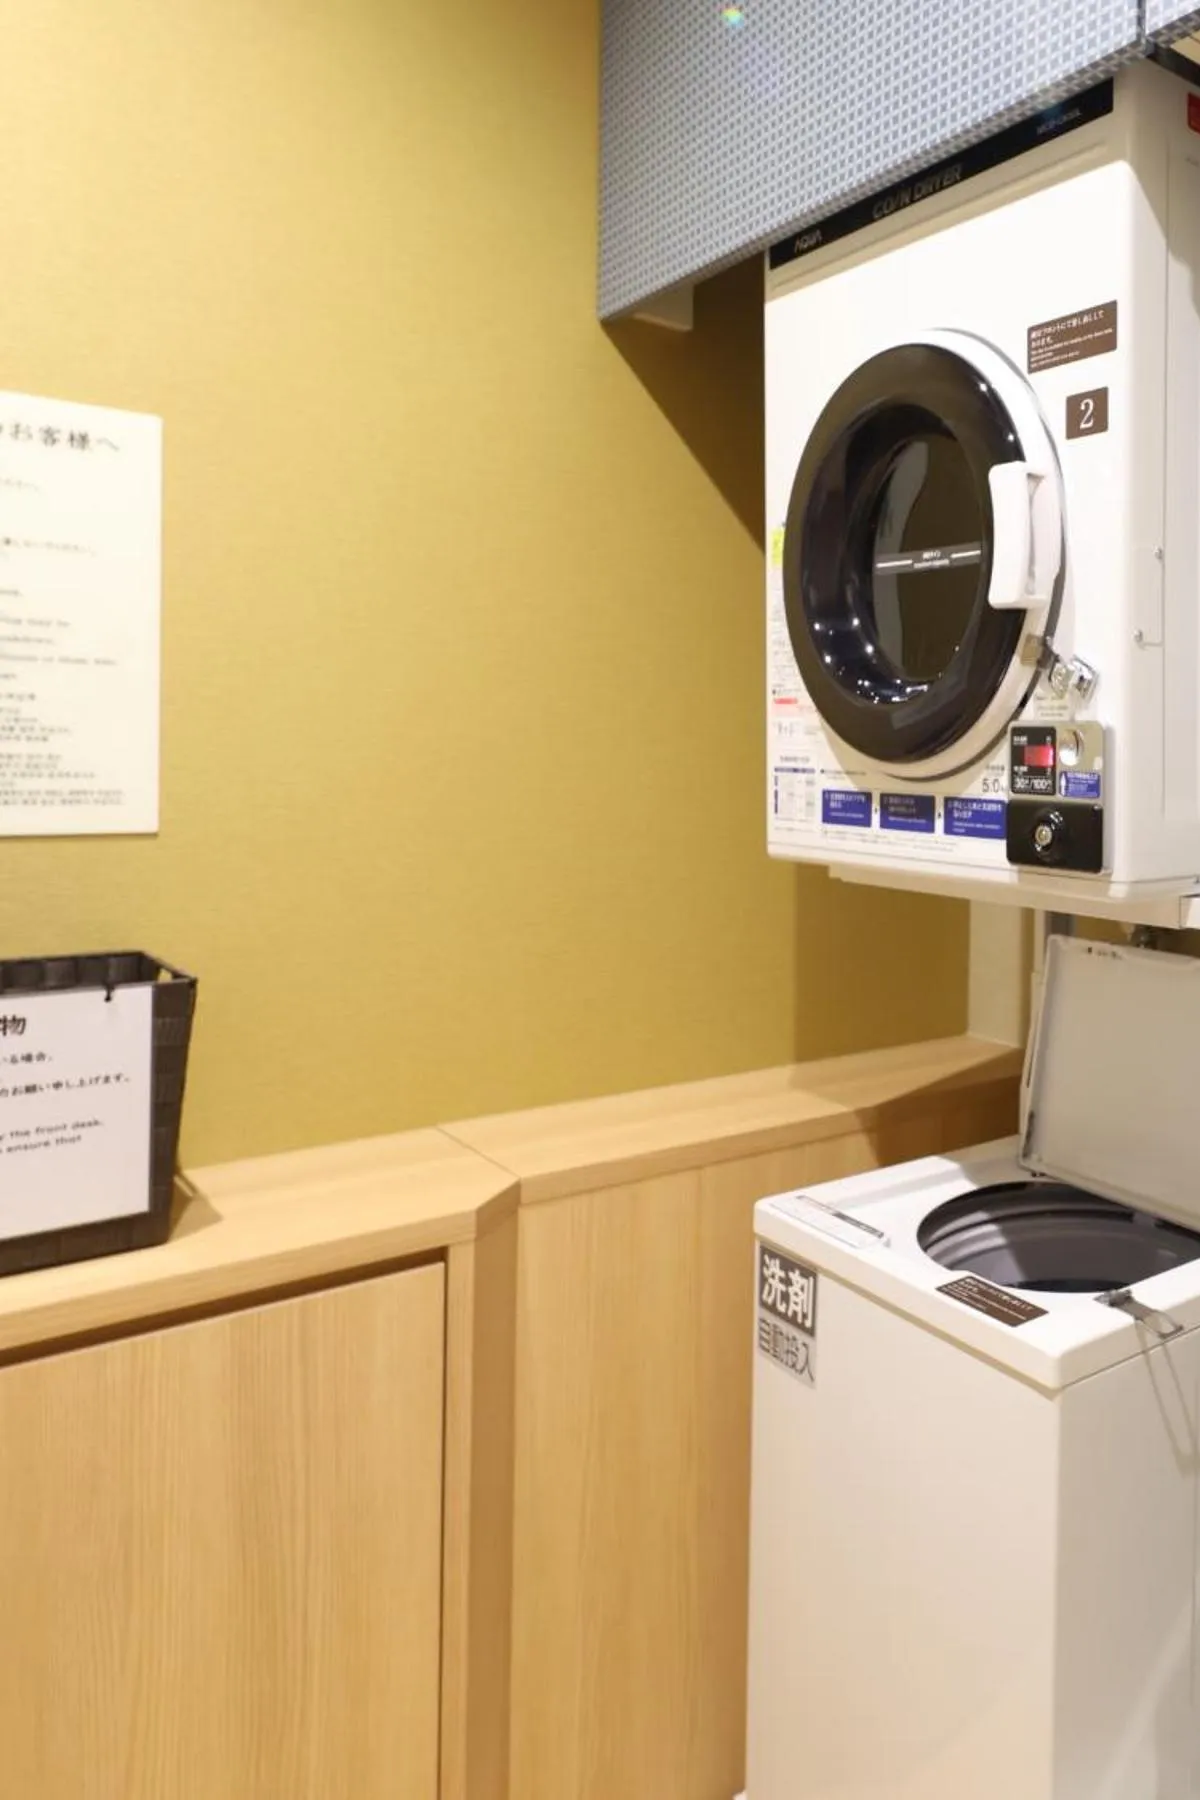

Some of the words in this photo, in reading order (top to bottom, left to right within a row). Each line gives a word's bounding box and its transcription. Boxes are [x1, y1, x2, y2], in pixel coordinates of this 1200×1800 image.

[1079, 397, 1095, 430] 2
[0, 421, 120, 454] お客様へ
[0, 1014, 26, 1036] 物
[9, 1128, 31, 1140] the
[35, 1122, 68, 1136] front
[762, 1254, 815, 1329] 洗剤
[758, 1318, 815, 1383] 自動投入
